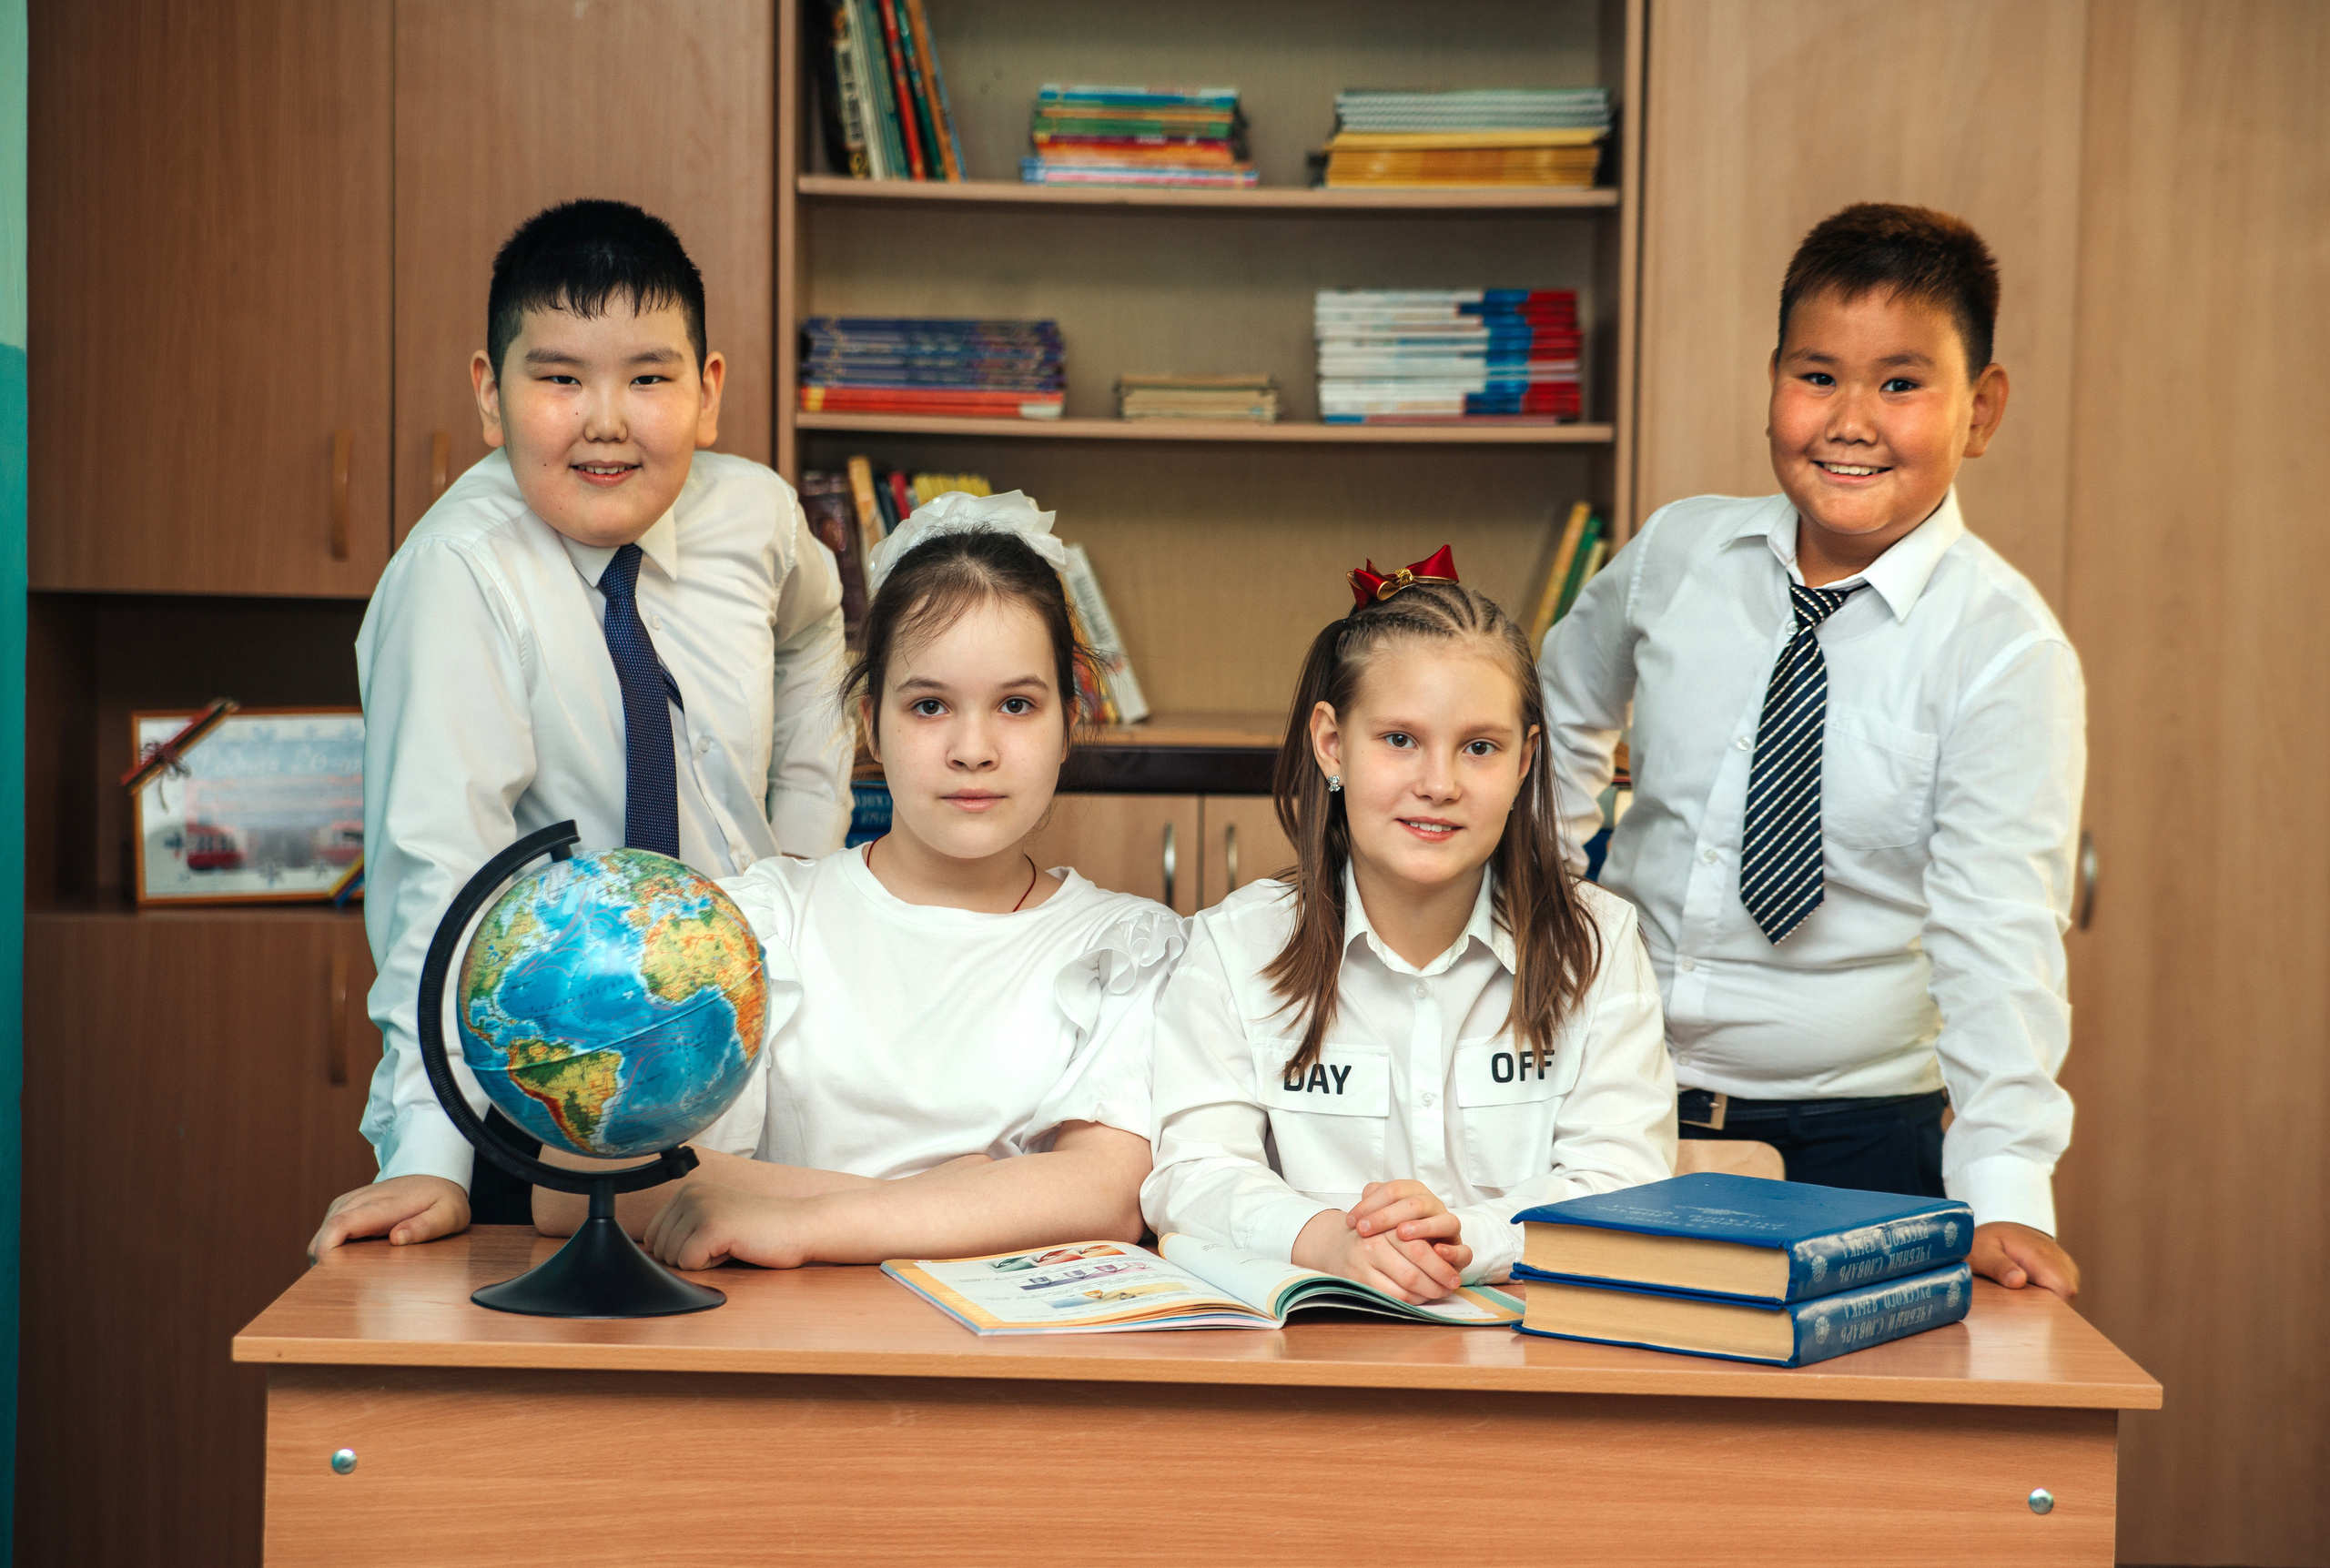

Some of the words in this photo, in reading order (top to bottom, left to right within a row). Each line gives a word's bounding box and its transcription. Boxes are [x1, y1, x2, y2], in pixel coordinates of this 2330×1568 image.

[1284, 1061, 1352, 1095] DAY
[1492, 1049, 1555, 1083] OFF
[1841, 1234, 1877, 1259] ЯЗЫКА
[1880, 1221, 1929, 1249] РУССКОГО
[1839, 1256, 1883, 1282] СЛОВАРЬ
[1843, 1297, 1879, 1320] ЯЗЫКА
[1883, 1284, 1931, 1310] РУССКОГО
[1840, 1317, 1884, 1343] СЛОВАРЬ
